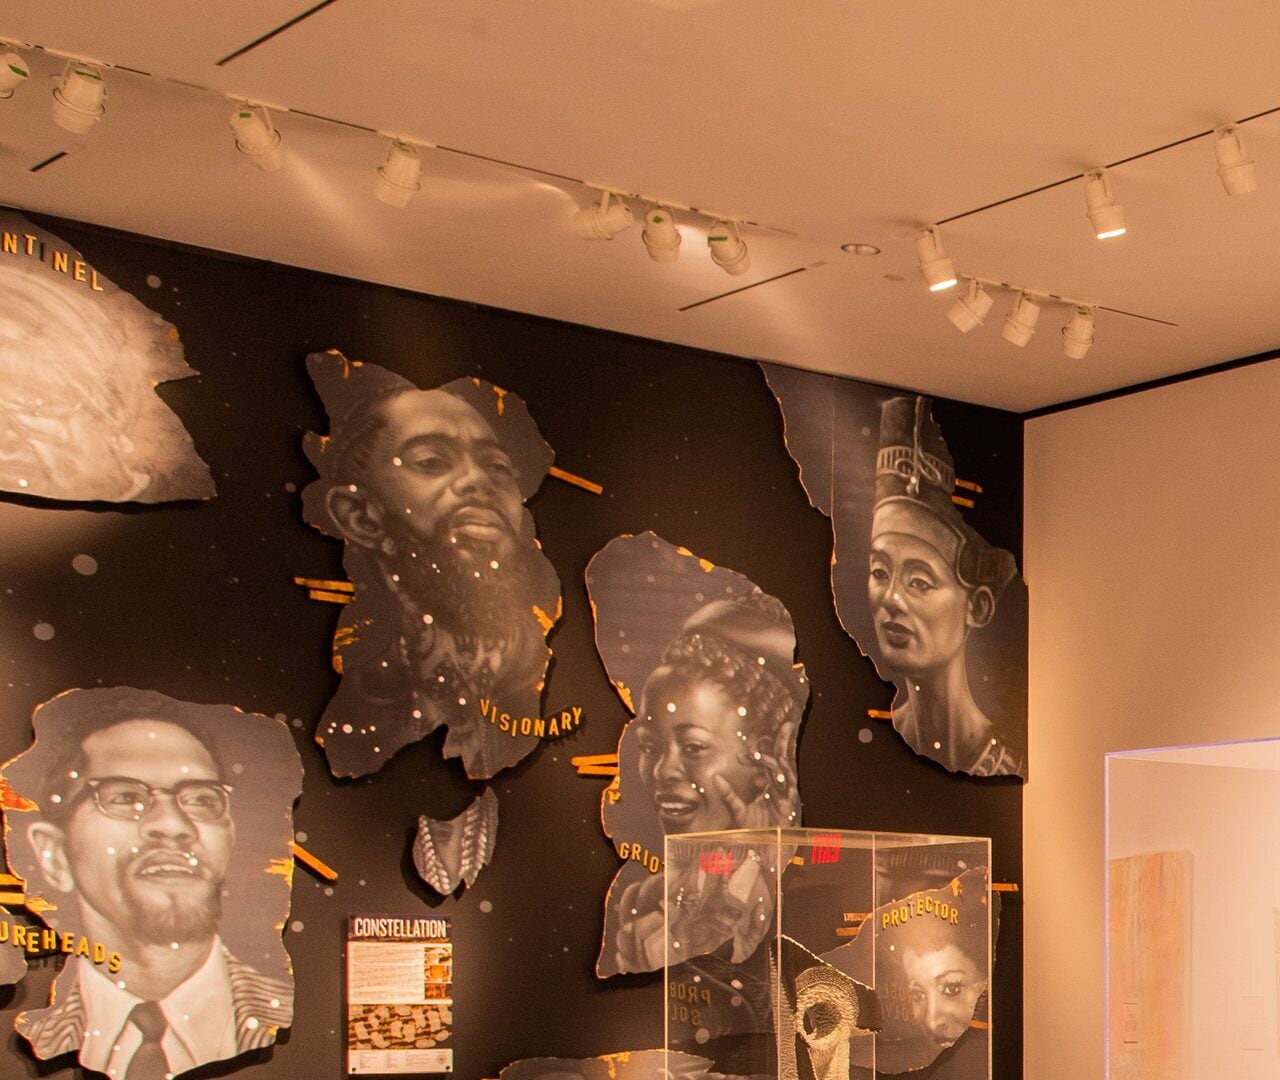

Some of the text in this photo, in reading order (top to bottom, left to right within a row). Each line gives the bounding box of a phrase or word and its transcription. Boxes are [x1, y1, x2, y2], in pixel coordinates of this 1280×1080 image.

[480, 699, 582, 737] VISIONARY
[354, 918, 447, 938] CONSTELLATION
[882, 896, 959, 929] PROTECTOR
